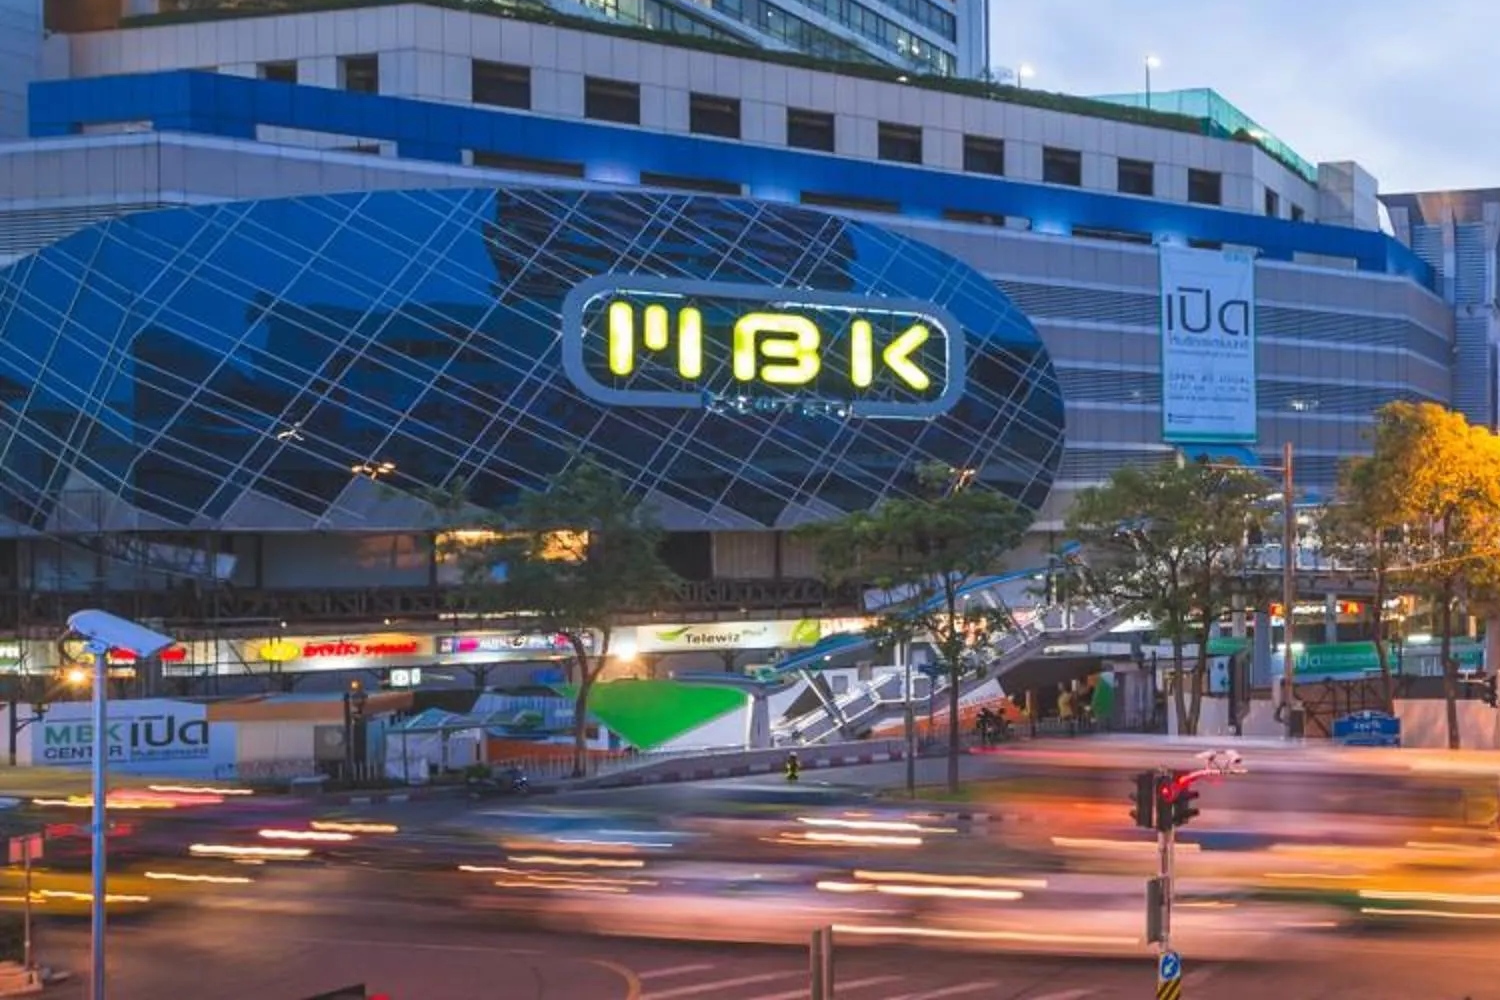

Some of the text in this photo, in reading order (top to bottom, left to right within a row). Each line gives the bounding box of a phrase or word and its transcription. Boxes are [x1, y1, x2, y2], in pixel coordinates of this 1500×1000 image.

[607, 300, 931, 391] MBK
[43, 722, 124, 746] MBK
[43, 745, 123, 761] CENTR
